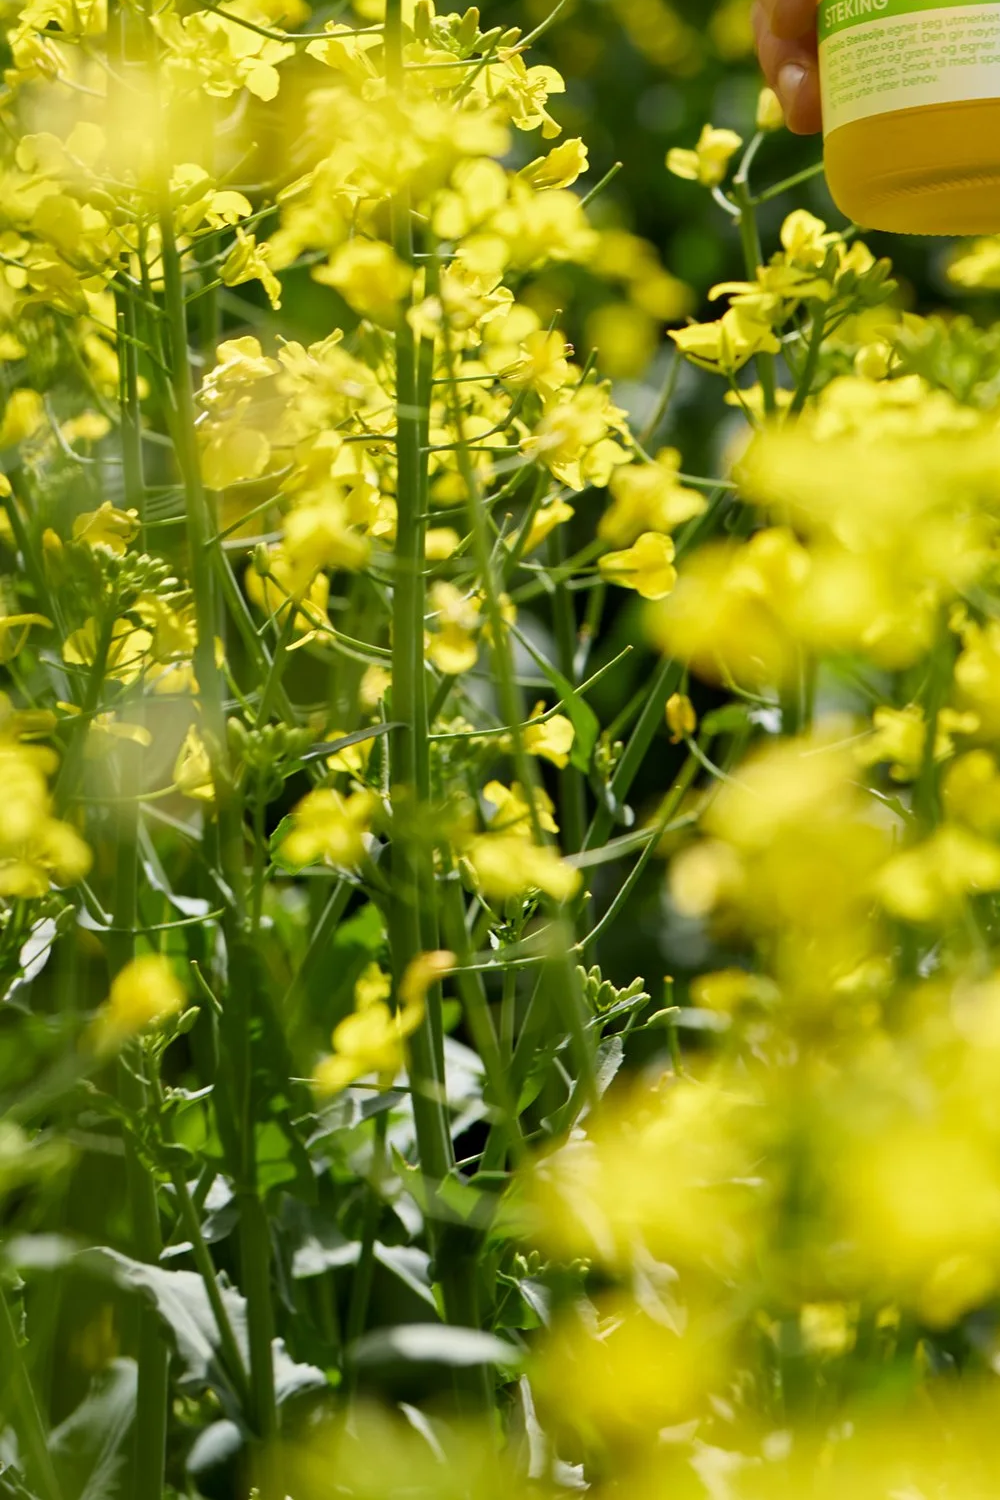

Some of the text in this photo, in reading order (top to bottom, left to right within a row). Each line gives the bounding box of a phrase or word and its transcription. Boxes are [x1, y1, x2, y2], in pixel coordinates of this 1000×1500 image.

[886, 22, 919, 37] egner
[921, 19, 942, 30] seg
[945, 12, 1000, 26] utmerket
[880, 40, 895, 52] og
[921, 31, 946, 43] Den
[949, 29, 964, 42] gir
[886, 53, 901, 65] og
[940, 44, 957, 56] og
[959, 40, 996, 54] egner
[901, 60, 932, 75] Smak
[935, 57, 946, 69] til
[949, 54, 976, 67] med
